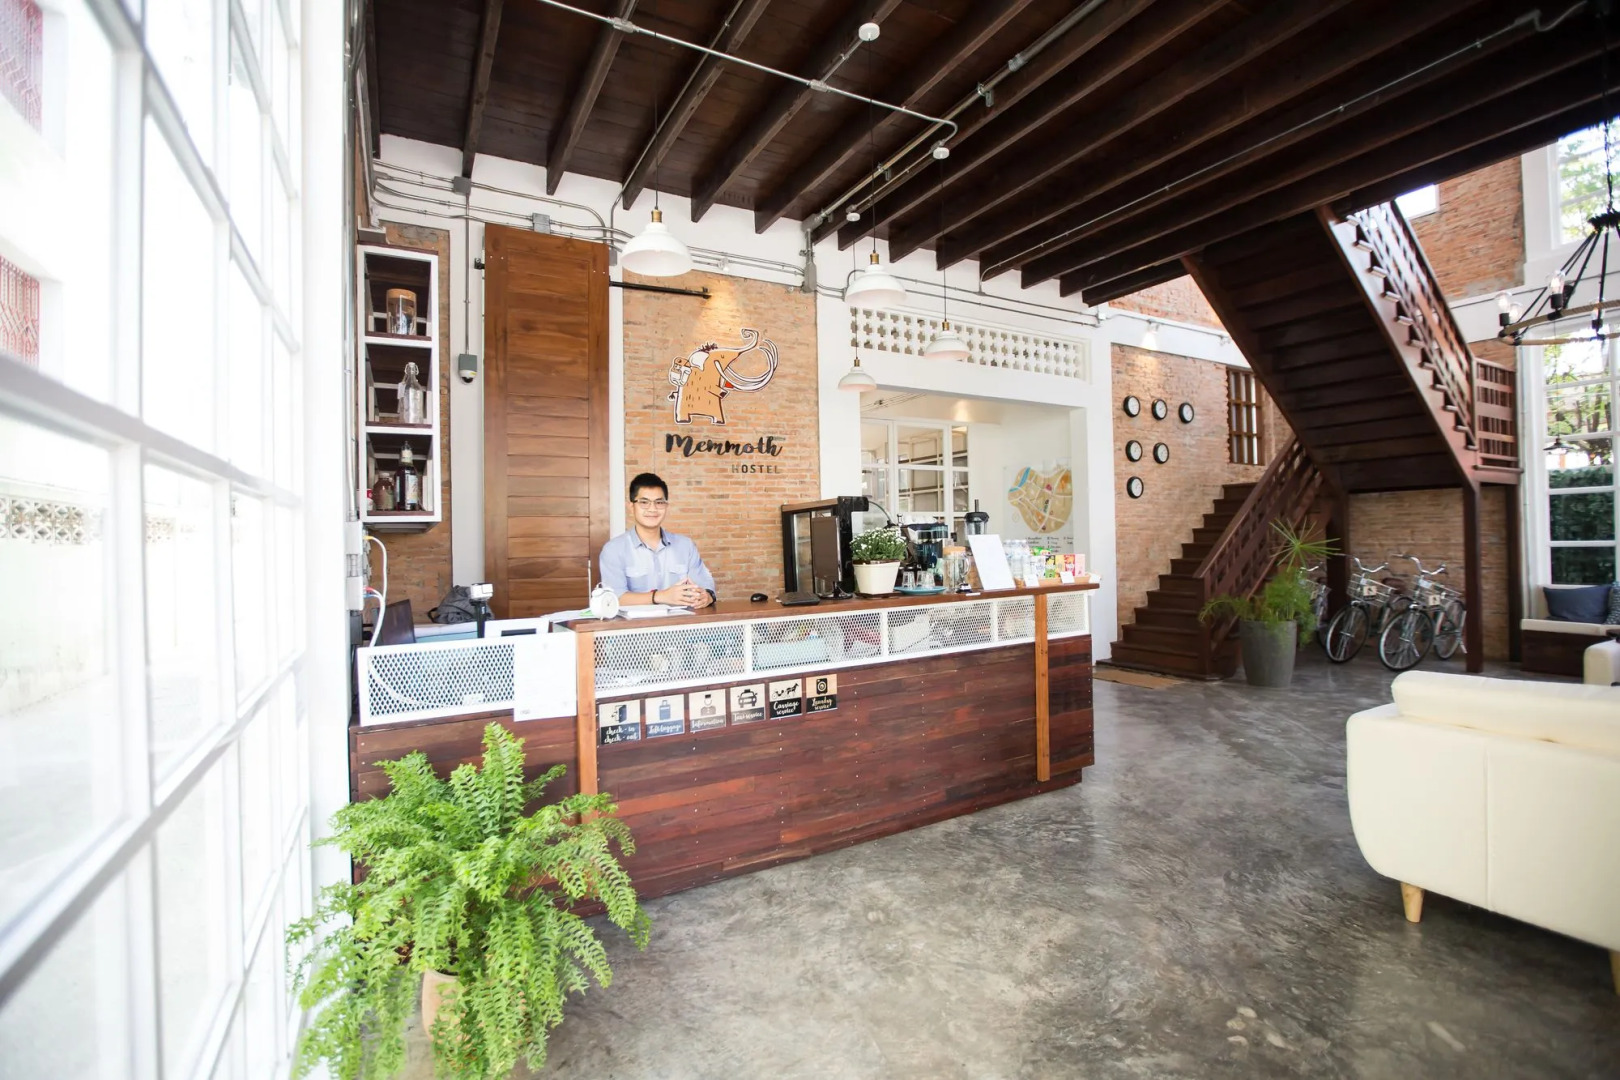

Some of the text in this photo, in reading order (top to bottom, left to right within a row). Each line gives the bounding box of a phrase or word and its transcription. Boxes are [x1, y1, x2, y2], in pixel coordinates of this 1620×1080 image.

[665, 433, 783, 457] Memmoth
[731, 464, 780, 474] HOSTEL
[773, 701, 799, 711] Carriage
[812, 698, 832, 707] Laundry
